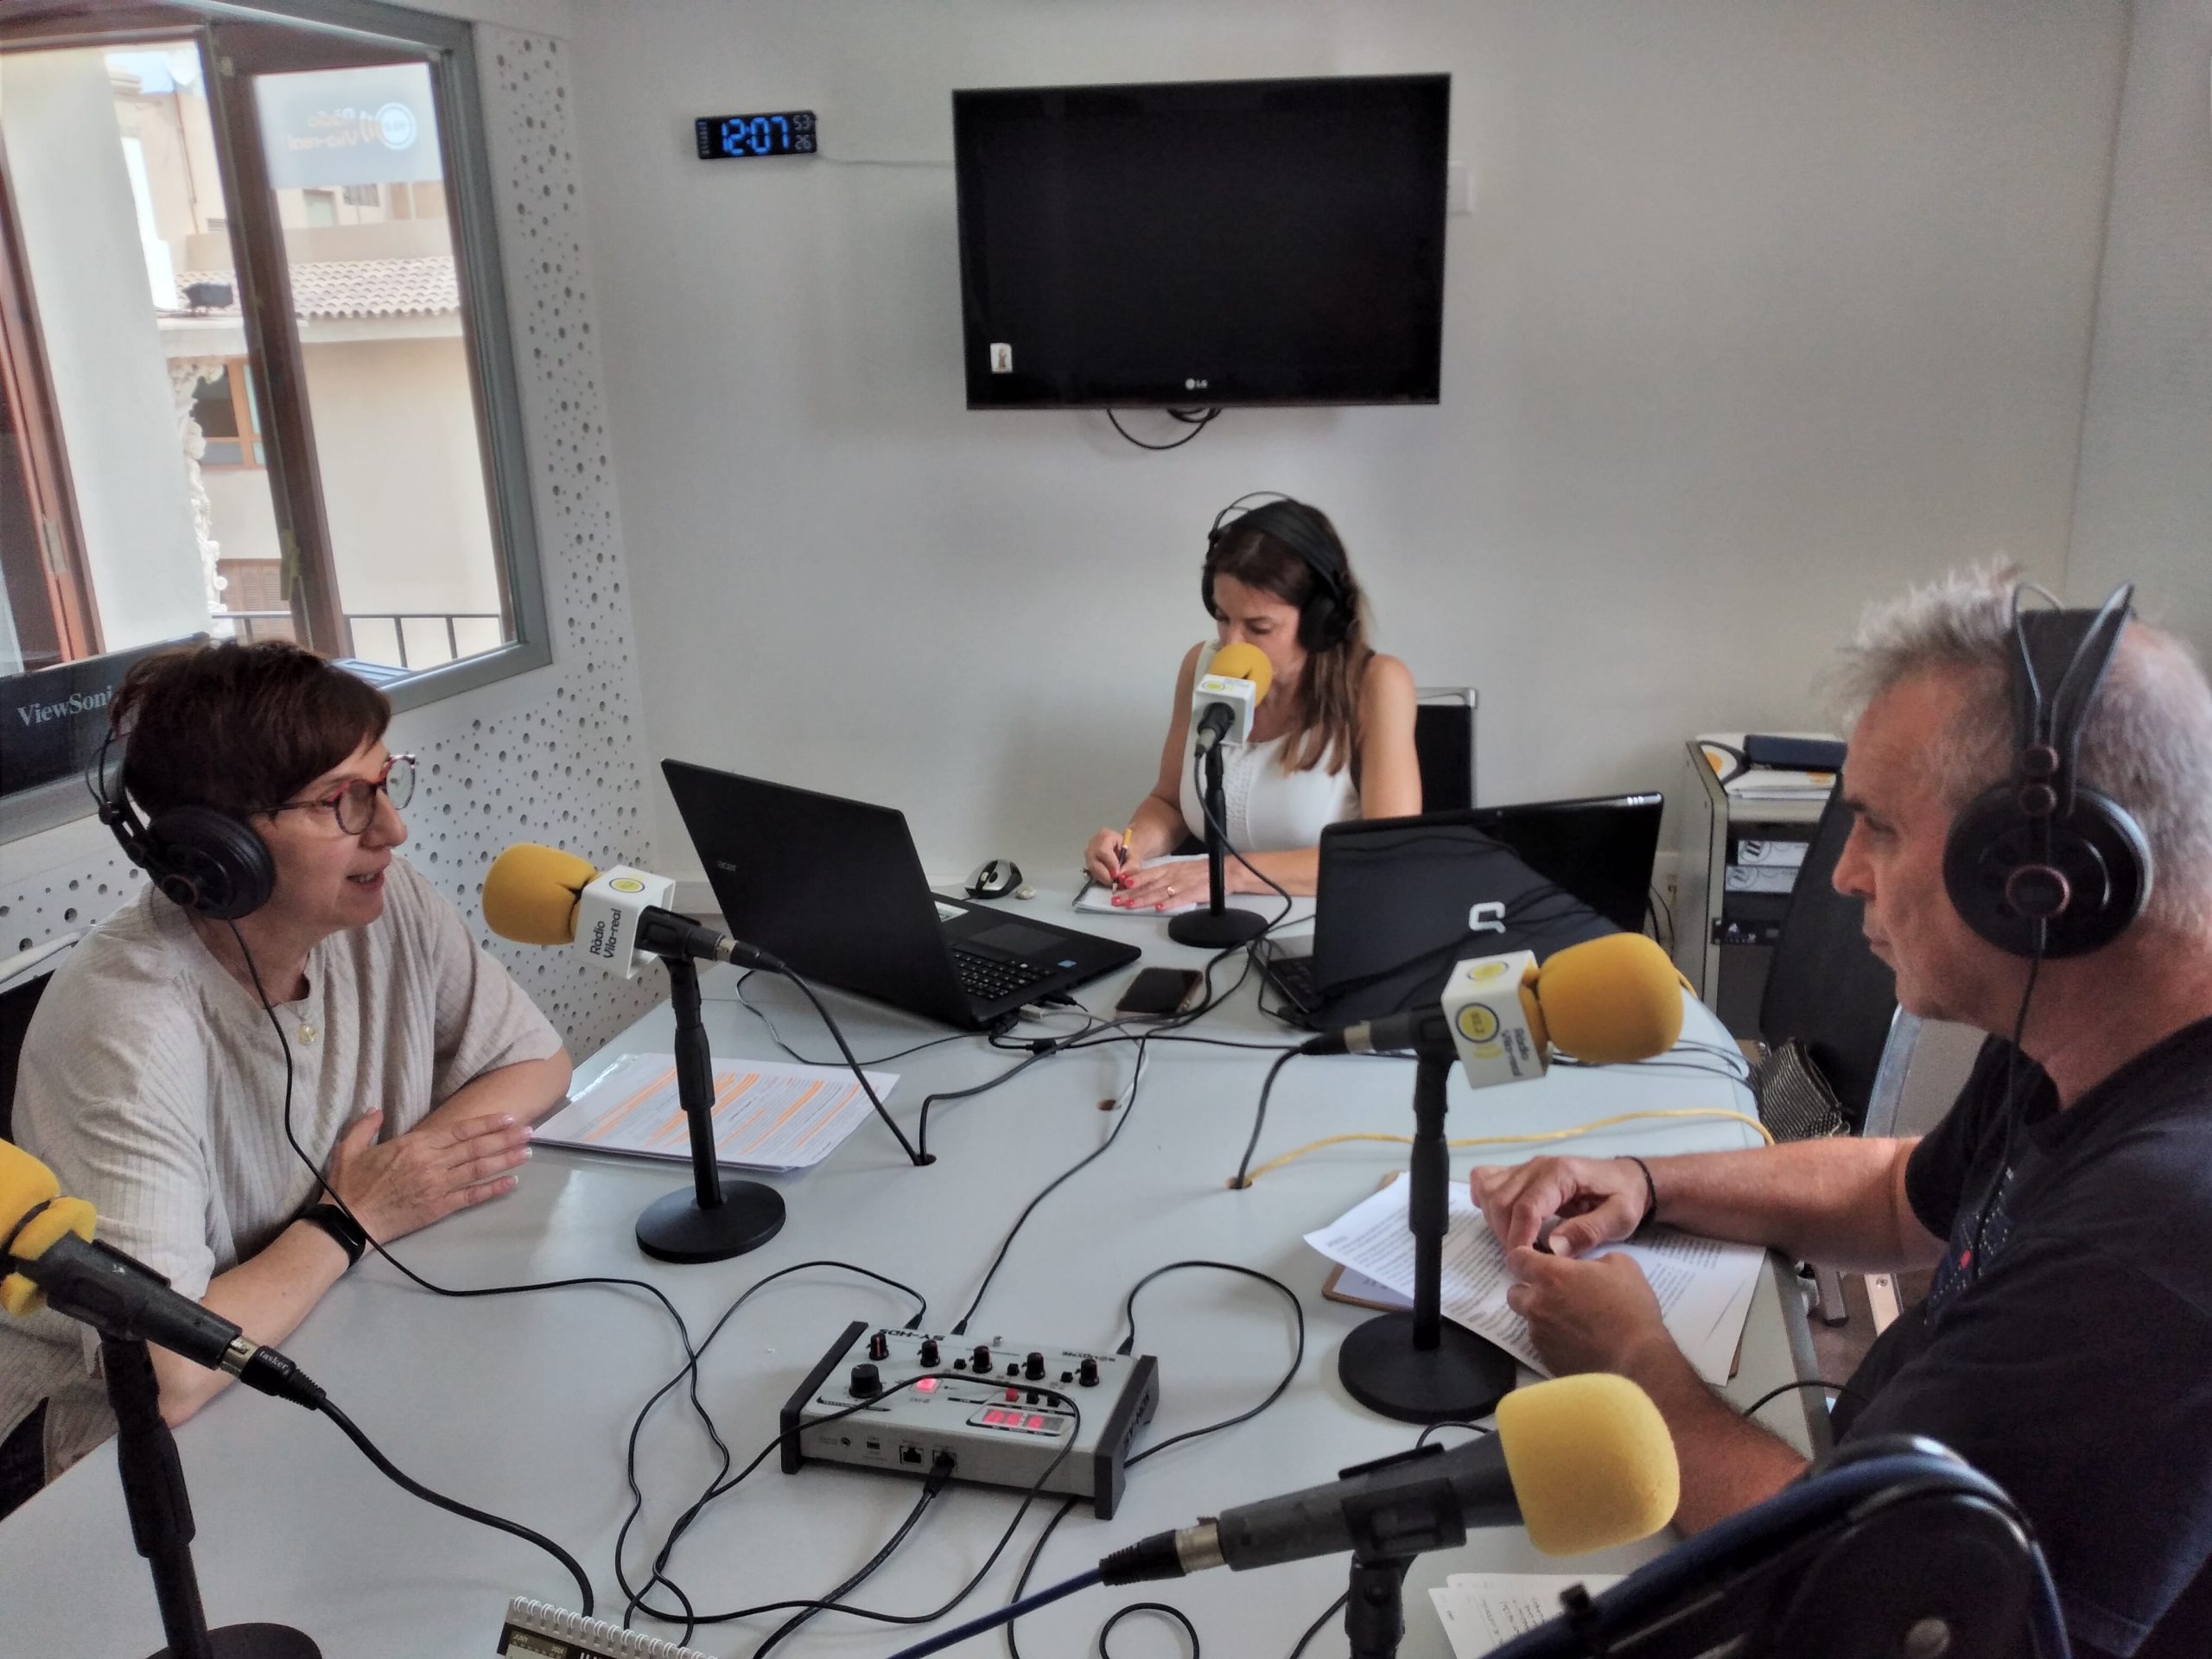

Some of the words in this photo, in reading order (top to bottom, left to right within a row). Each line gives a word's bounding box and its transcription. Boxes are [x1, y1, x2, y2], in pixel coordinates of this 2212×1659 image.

[721, 115, 789, 156] 12:07
[16, 685, 112, 727] ViewSoni
[589, 920, 606, 956] Ràdio
[603, 908, 622, 958] Vila-real
